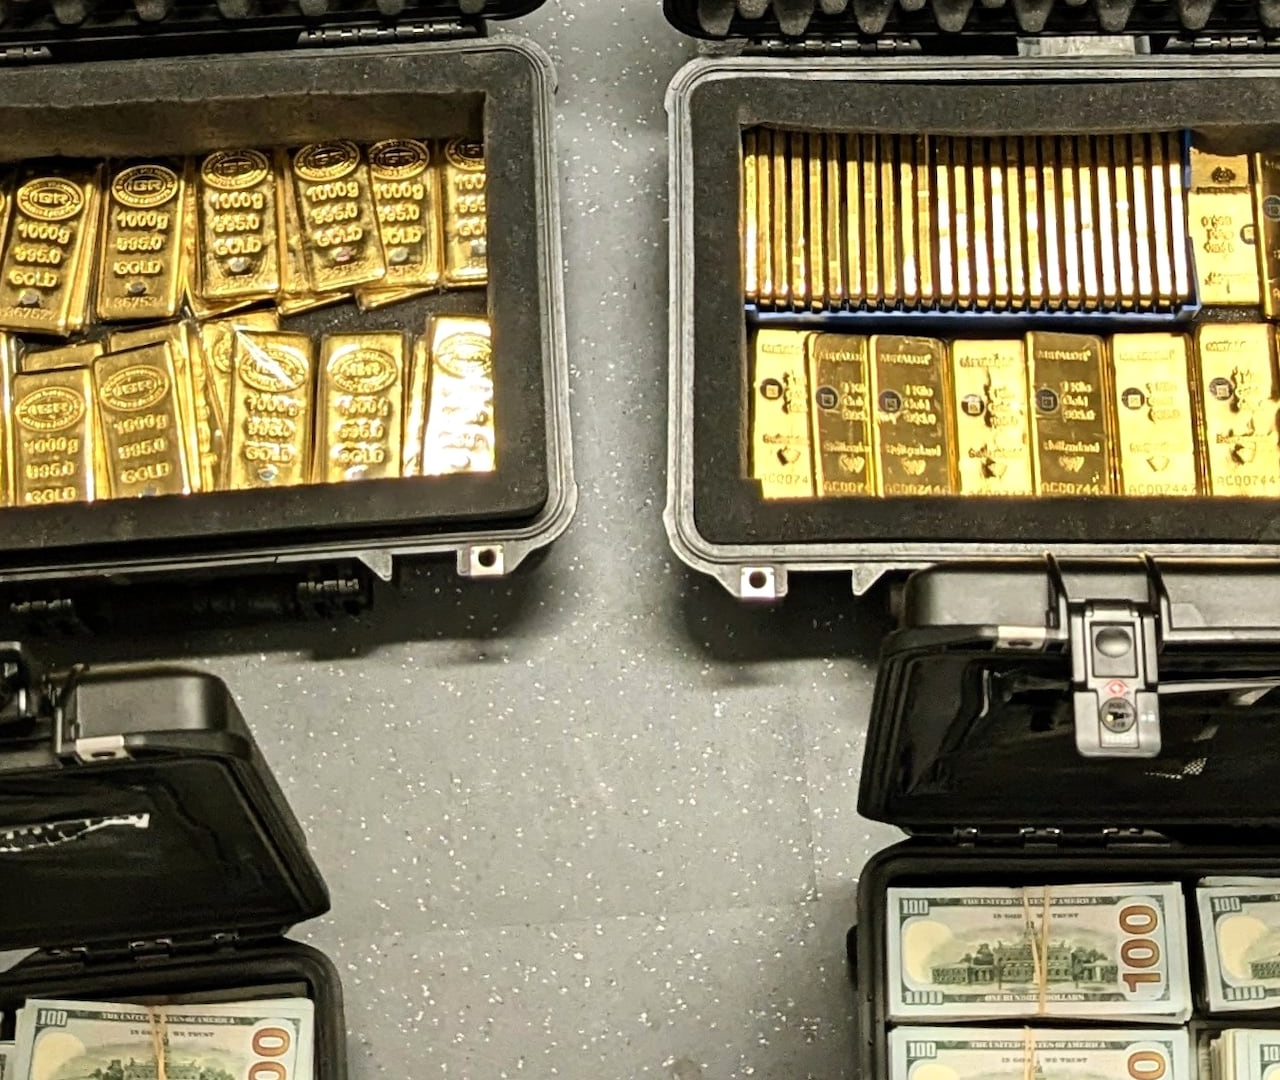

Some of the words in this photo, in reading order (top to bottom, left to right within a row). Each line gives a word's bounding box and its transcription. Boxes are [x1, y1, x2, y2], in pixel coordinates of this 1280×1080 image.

[128, 179, 162, 192] IGR
[307, 181, 359, 201] 1000g
[374, 183, 424, 201] 1000g
[32, 190, 69, 205] IGR
[212, 192, 263, 209] 1000g
[117, 211, 169, 230] 1000g
[18, 222, 70, 245] 1000g
[316, 225, 363, 247] GOLD
[117, 237, 162, 251] 995.0
[215, 237, 261, 256] GOLD
[15, 245, 61, 264] 995.0
[114, 260, 161, 275] GOLD
[10, 271, 58, 288] GOLD
[24, 437, 79, 454] 1000g
[121, 463, 169, 484] GOLD
[25, 486, 77, 503] GOLD
[902, 899, 929, 915] 100
[1213, 897, 1241, 912] 100
[1119, 904, 1162, 993] 100
[39, 1009, 67, 1026] 100
[908, 1042, 937, 1057] 100
